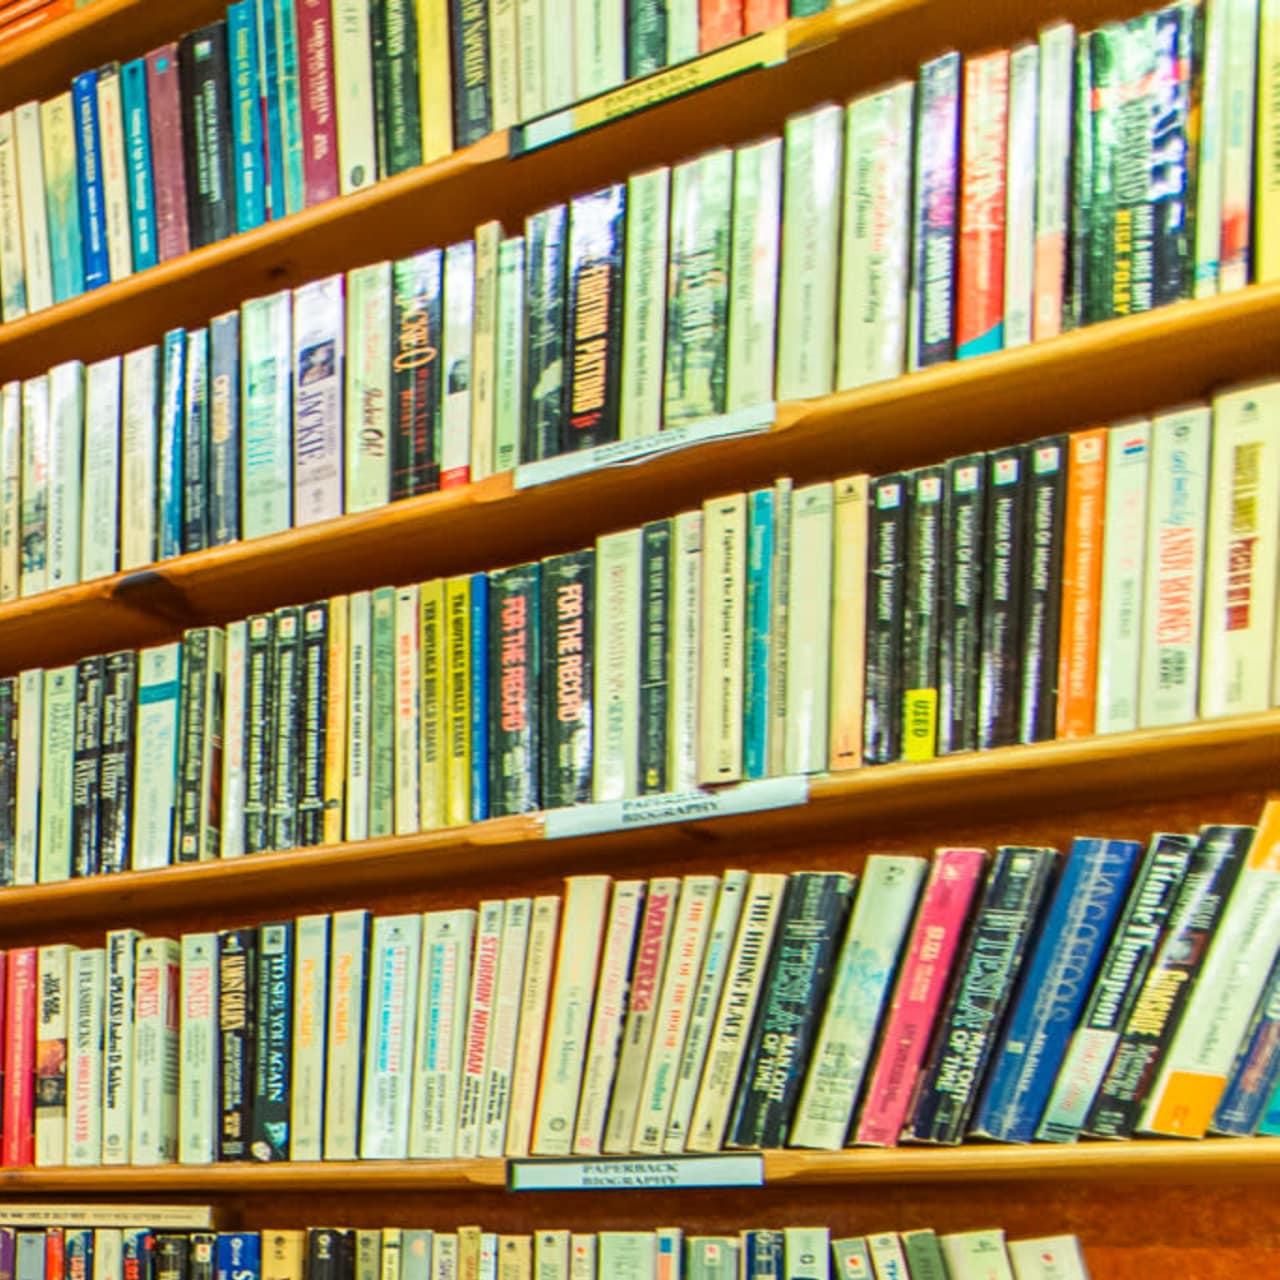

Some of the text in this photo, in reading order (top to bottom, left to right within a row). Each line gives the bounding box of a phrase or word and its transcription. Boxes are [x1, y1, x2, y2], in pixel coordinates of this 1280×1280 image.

[1114, 210, 1130, 252] MICK
[1156, 527, 1197, 646] ANDY ROONEY
[501, 595, 527, 732] FOR THE RECORD
[558, 583, 584, 722] FOR THE RECORD
[912, 699, 932, 740] USED
[720, 892, 774, 1043] THE HIDING PLACE
[1091, 852, 1190, 1027] Titanic Thompson
[465, 936, 499, 1075] STORMIN' NORMAN
[1126, 968, 1189, 1036] GUMSHOE
[268, 1049, 284, 1101] AGAIN
[753, 1033, 781, 1092] OF TIME
[767, 1033, 800, 1102] MAN OUT
[936, 1029, 967, 1091] OF TIME
[962, 1032, 987, 1067] MAN
[952, 1068, 978, 1103] OUT
[581, 1163, 679, 1174] PAPERBACK
[581, 1175, 679, 1185] BIOGRAPHY
